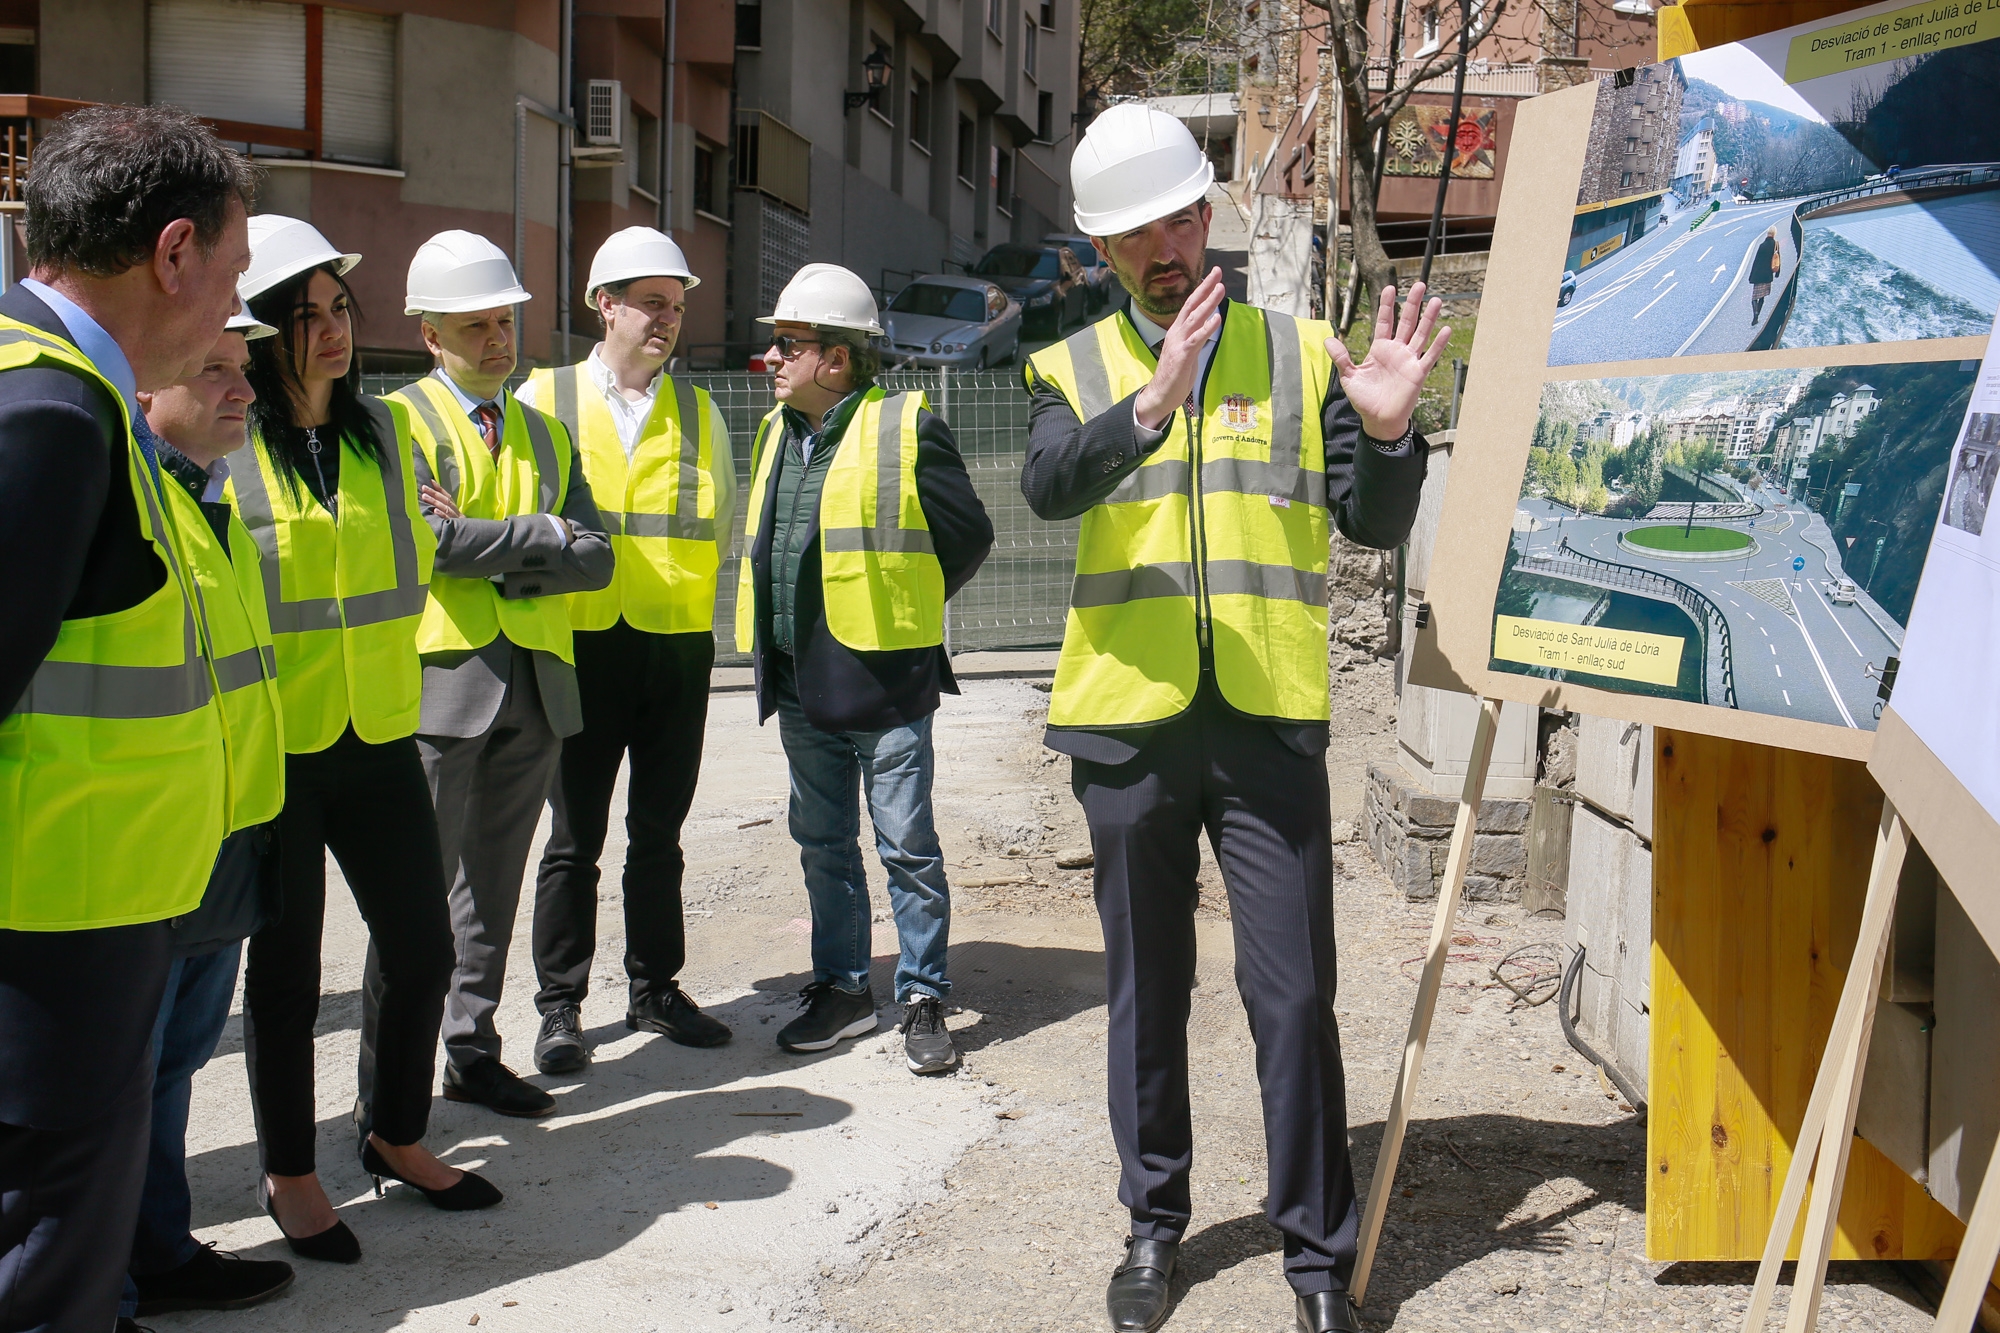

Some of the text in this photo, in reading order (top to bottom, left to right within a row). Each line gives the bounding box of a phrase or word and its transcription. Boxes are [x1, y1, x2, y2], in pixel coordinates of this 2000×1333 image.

[1811, 28, 1869, 52] Desviació
[1873, 23, 1890, 37] de
[1893, 14, 1925, 32] Sant
[1927, 4, 1959, 24] Julià
[1963, 0, 1982, 15] de
[1844, 46, 1876, 62] Tram
[1881, 42, 1887, 54] 1
[1900, 30, 1940, 50] enllaç
[1944, 21, 1977, 41] nord
[1212, 434, 1267, 445] Govern d'Andorra
[1512, 624, 1660, 656] Desviació de Sant Julià de Lòria
[1538, 646, 1560, 661] Tram
[1563, 651, 1568, 662] 1
[1577, 654, 1604, 670] enllaç
[1607, 658, 1625, 670] sud
